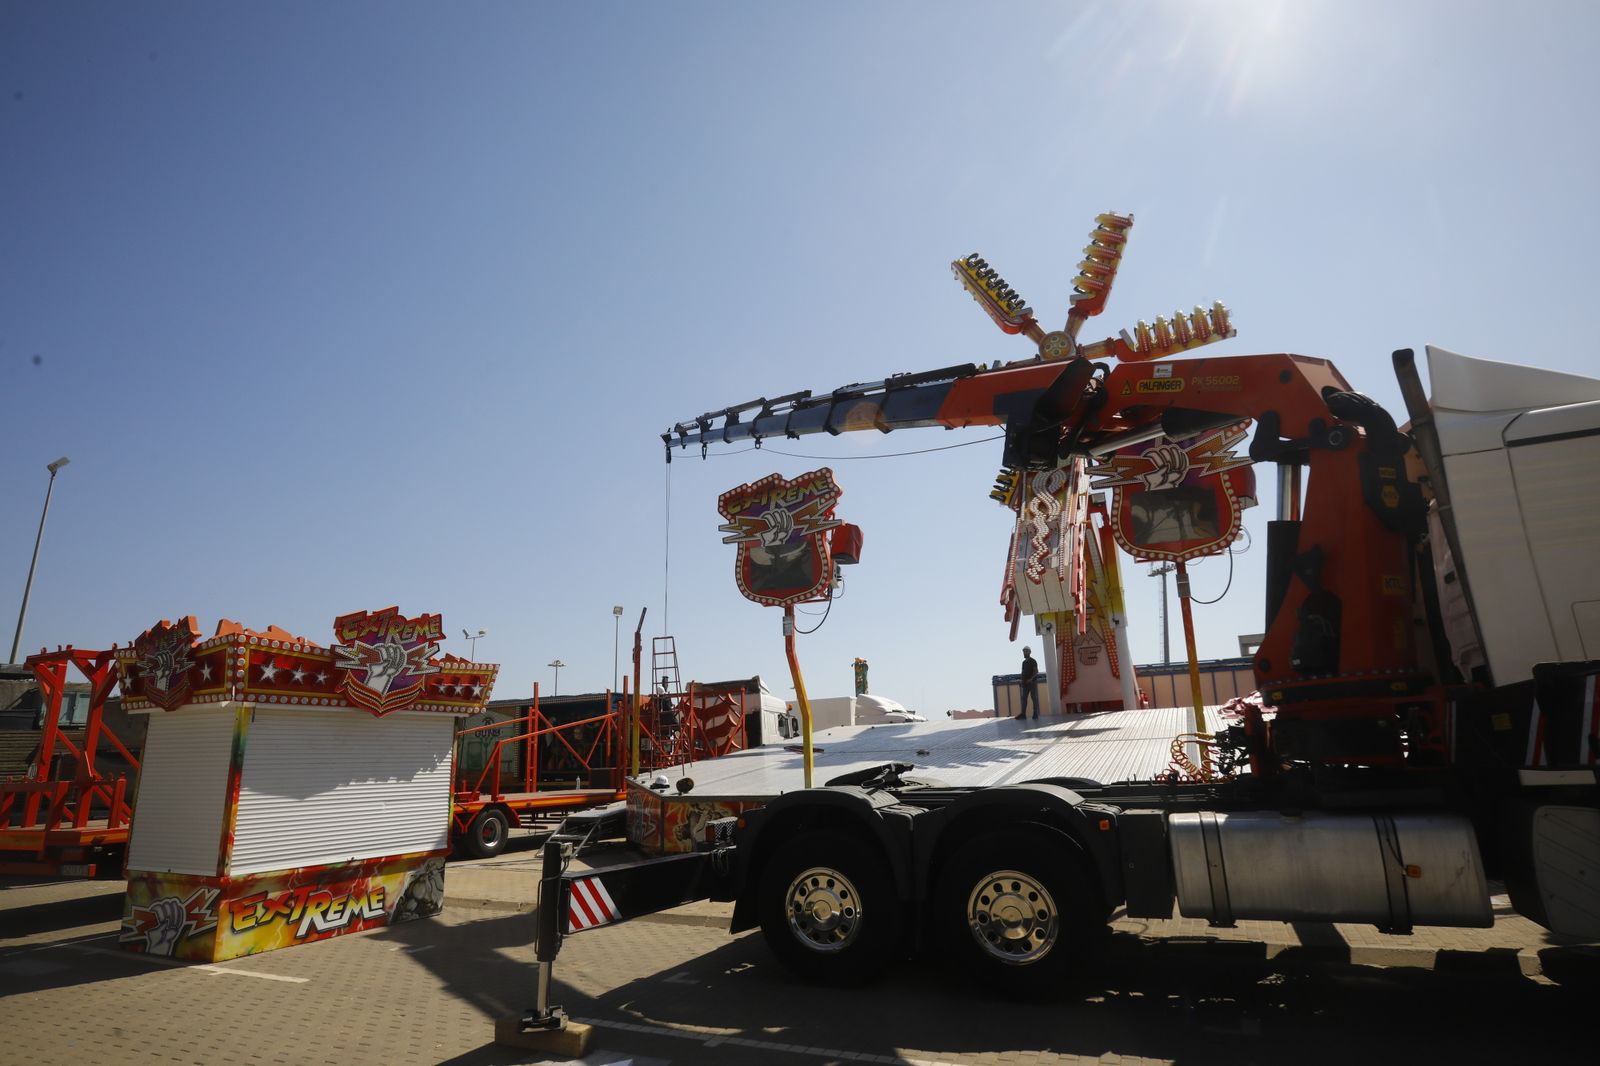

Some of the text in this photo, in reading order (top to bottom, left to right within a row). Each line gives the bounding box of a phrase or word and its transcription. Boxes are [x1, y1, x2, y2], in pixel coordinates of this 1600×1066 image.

[1139, 380, 1182, 391] PALFINGER
[341, 611, 441, 645] EXTREME
[228, 886, 387, 938] EXTREME
